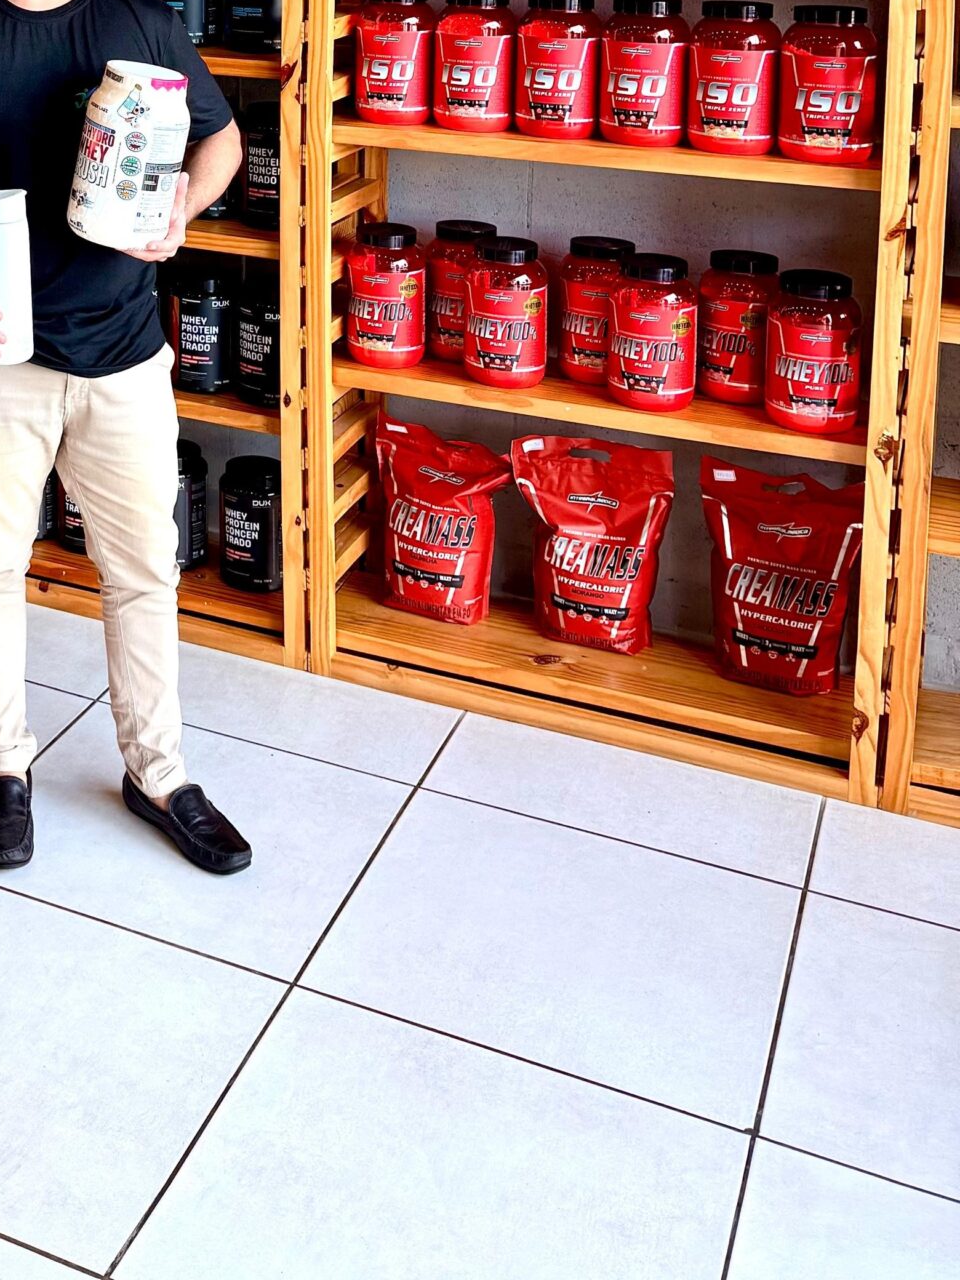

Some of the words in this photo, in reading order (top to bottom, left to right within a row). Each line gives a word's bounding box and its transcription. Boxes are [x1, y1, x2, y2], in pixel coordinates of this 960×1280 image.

[362, 58, 414, 81] ISO
[441, 65, 497, 86] ISO
[523, 66, 583, 91] ISO
[607, 72, 667, 97] ISO
[696, 80, 759, 106] ISO
[795, 88, 862, 113] ISO
[248, 146, 274, 156] WHEY
[248, 155, 279, 167] PROTEI
[248, 174, 277, 184] TRADO
[212, 300, 229, 308] DUX
[181, 314, 207, 325] WHEY
[181, 323, 219, 334] PROTEIN
[240, 321, 260, 334] WHEY
[181, 332, 217, 343] CONCEN
[240, 330, 272, 345] PROTEIN
[181, 341, 211, 352] TRADO
[240, 339, 270, 353] CONCEN
[240, 348, 263, 361] TRADO
[65, 503, 81, 514] TRA
[252, 499, 271, 507] DUX
[225, 507, 248, 519] WHEY
[225, 516, 260, 531] PROTEIN
[389, 499, 477, 548] CREAMASS
[225, 525, 259, 540] CONCEN
[225, 534, 252, 548] TRADO
[399, 541, 460, 561] HYPERCALORIC
[544, 535, 645, 581] CREAMASS
[558, 575, 625, 593] HYPERCALORIC
[725, 563, 838, 617] CREAMASS
[571, 588, 605, 599] MORANGO
[740, 608, 814, 631] HYPERCALORIC
